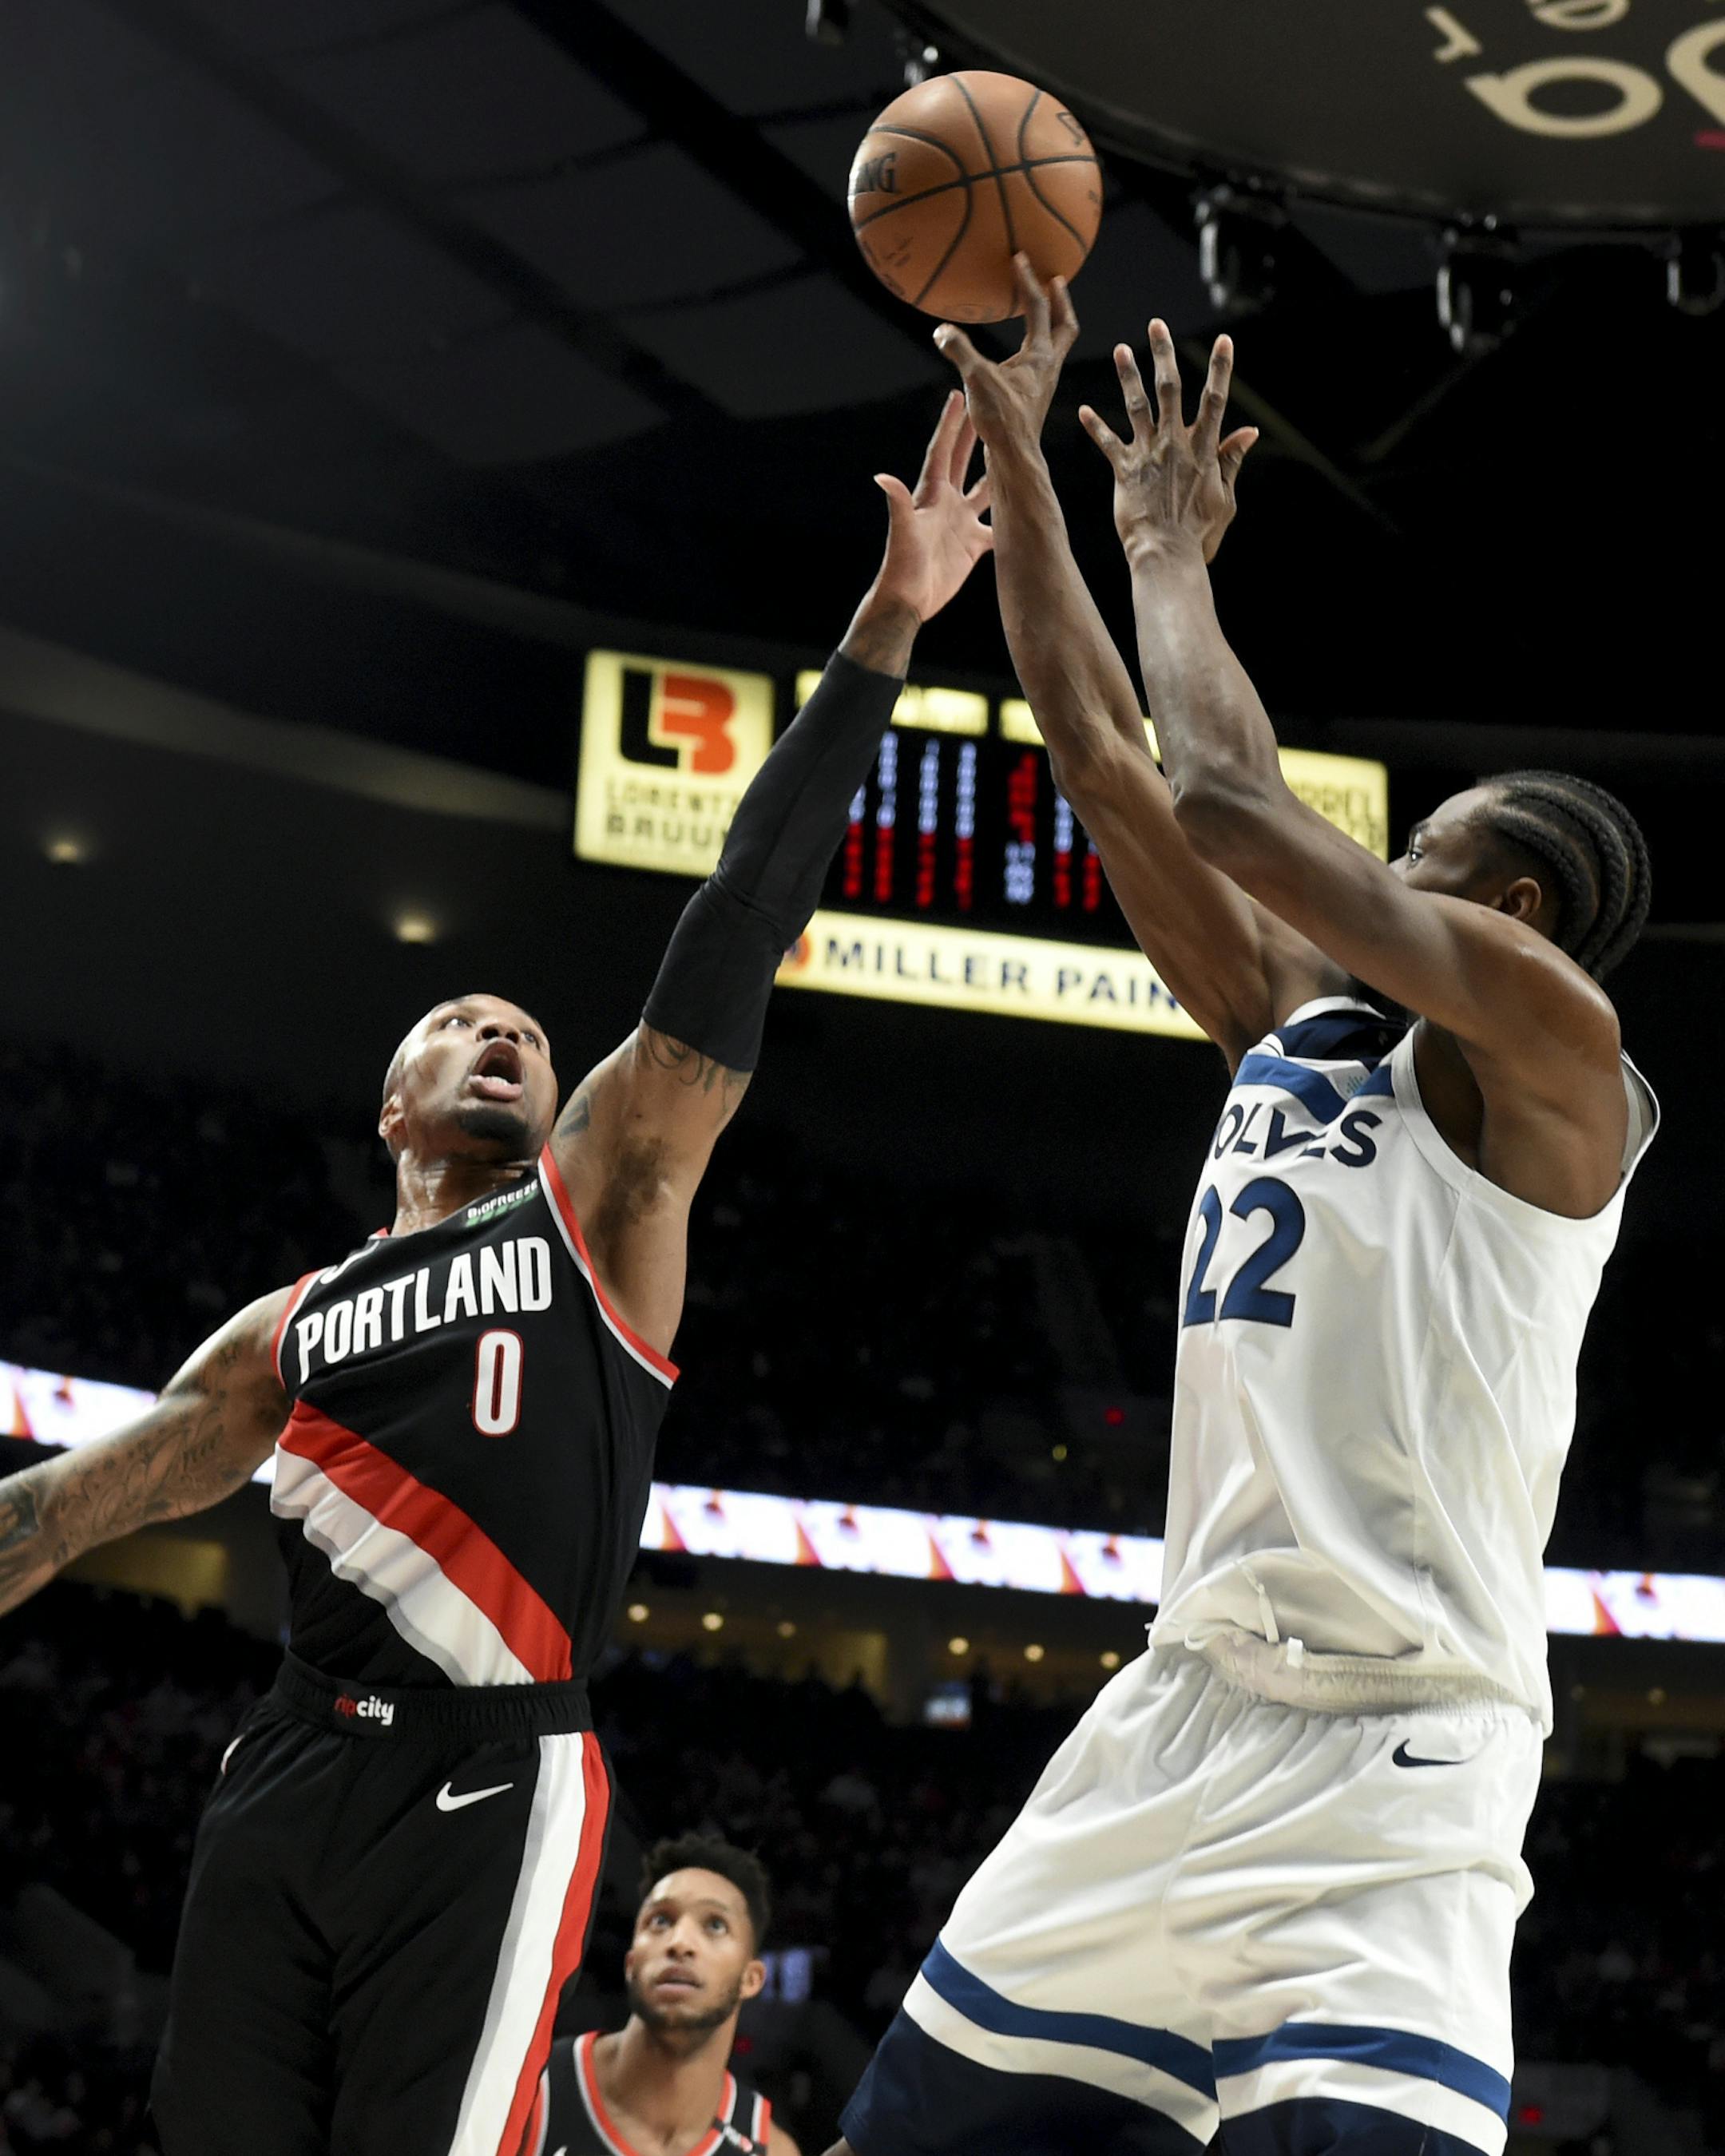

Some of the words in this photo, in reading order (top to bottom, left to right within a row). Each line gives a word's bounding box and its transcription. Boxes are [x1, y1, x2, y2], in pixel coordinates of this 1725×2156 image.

[826, 937, 1028, 994] MILLER
[295, 1236, 552, 1385] PORTLAND
[1183, 1176, 1306, 1328] 22
[472, 1328, 524, 1437] 0
